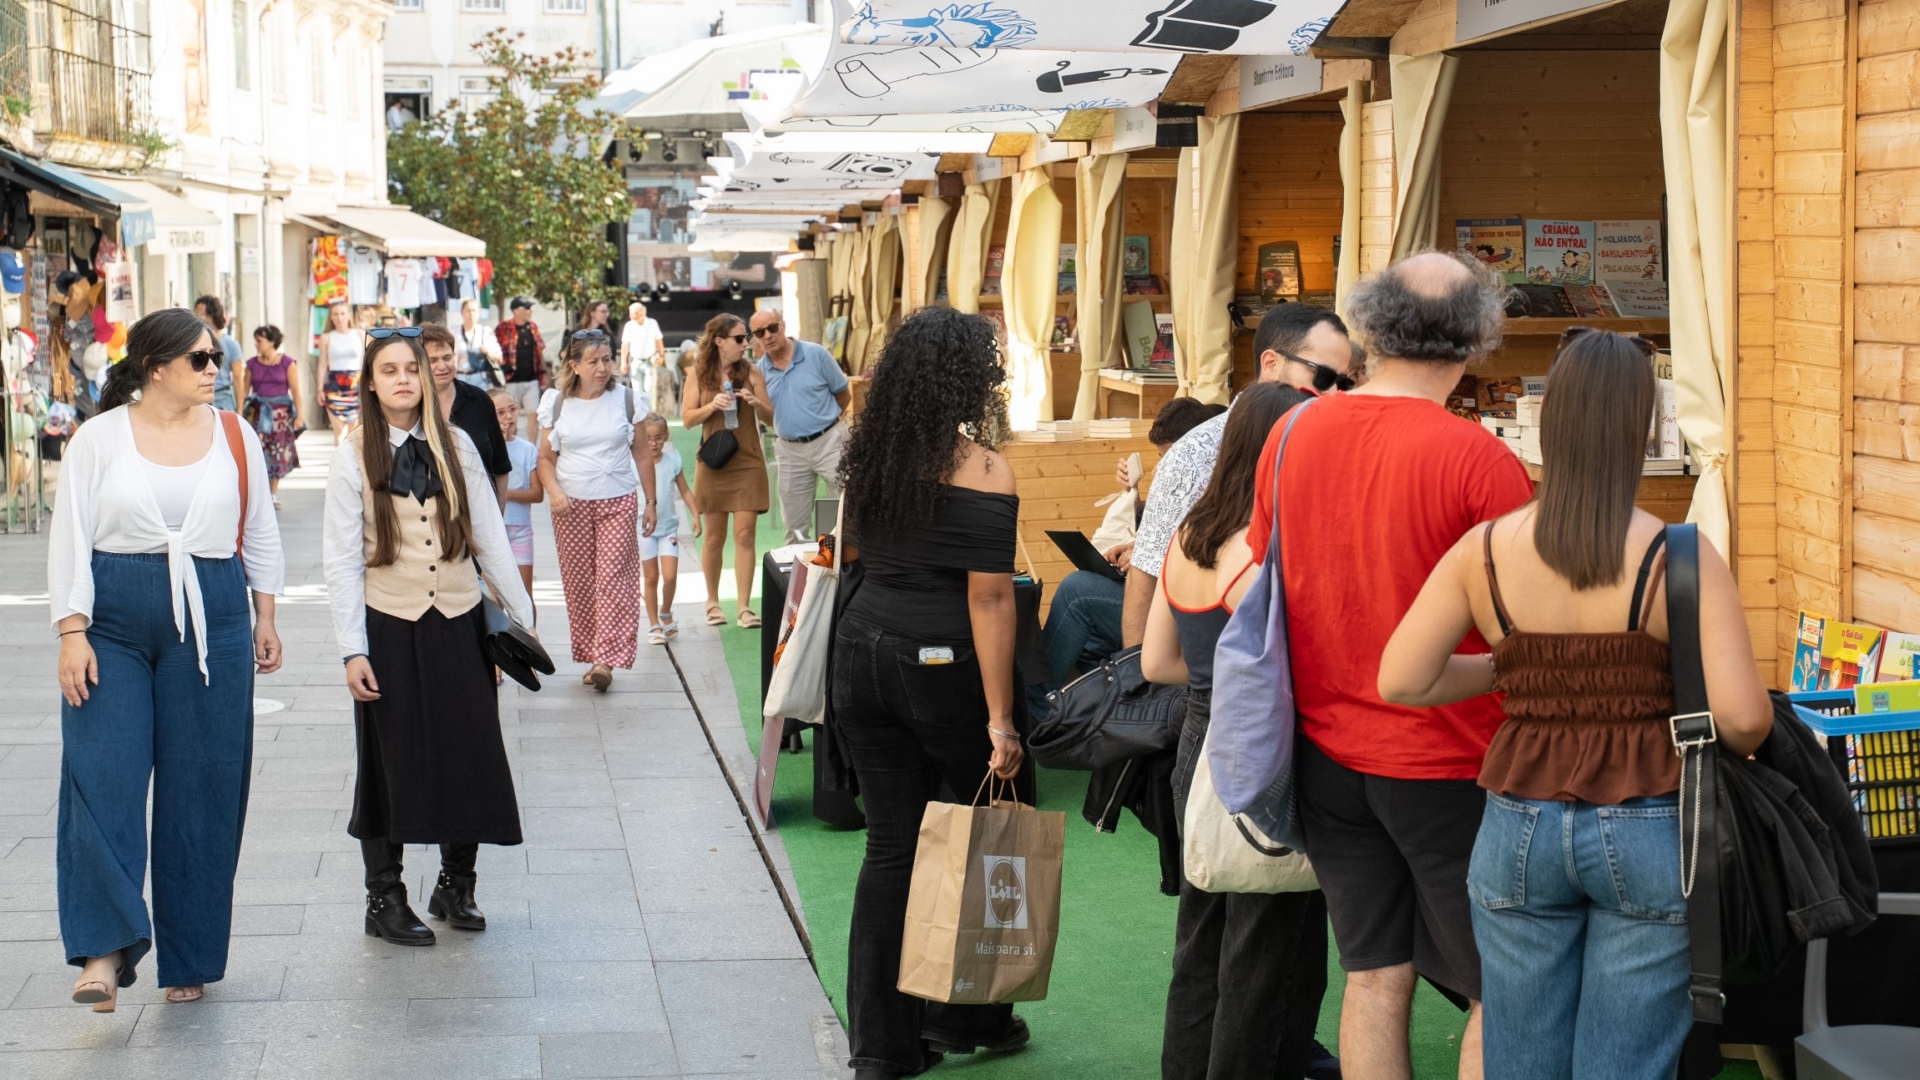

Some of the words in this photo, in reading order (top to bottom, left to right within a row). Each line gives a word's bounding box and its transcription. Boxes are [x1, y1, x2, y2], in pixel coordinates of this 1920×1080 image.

[1274, 63, 1295, 81] Editora
[1542, 224, 1580, 238] CRIANÇA
[1534, 234, 1554, 247] NÃO
[1556, 237, 1587, 249] ENTRA!
[1603, 235, 1642, 243] MOLHADOS
[1601, 249, 1647, 258] BARULHENTOS
[1603, 264, 1642, 273] PEGAJOSOS
[398, 273, 409, 291] 7
[974, 942, 996, 955] Mais
[996, 944, 1020, 957] para
[1022, 942, 1037, 956] si.
